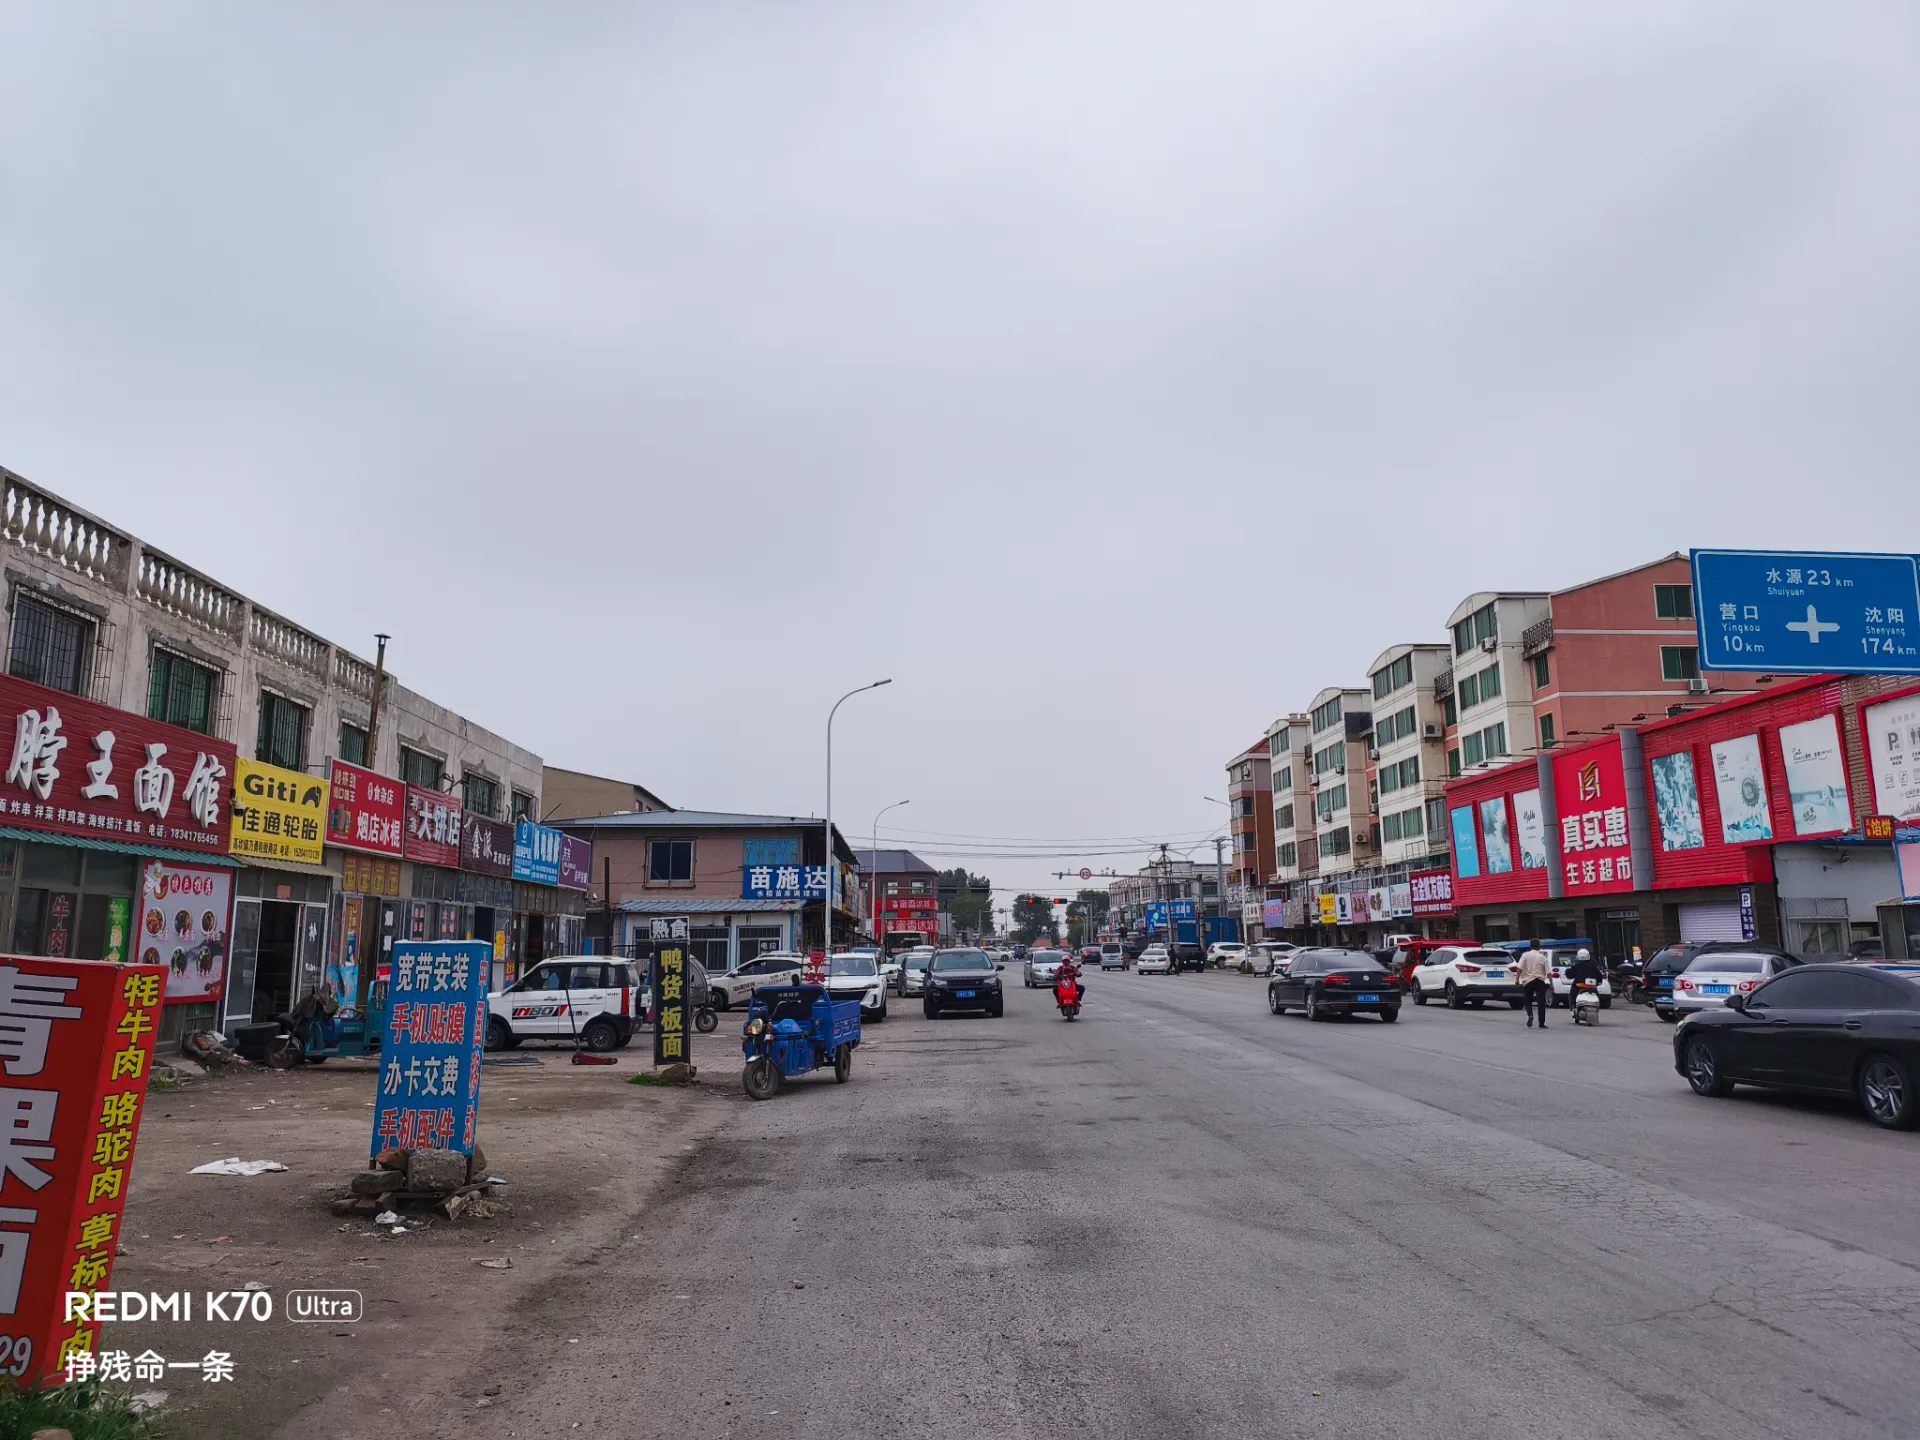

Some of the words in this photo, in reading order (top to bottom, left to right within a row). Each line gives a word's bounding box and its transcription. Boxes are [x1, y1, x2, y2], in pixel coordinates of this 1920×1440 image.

[1766, 568, 1803, 585] 水源
[1767, 587, 1805, 597] Shuiyuan
[1719, 603, 1759, 621] 营口
[1722, 623, 1761, 634] Yingkou
[1864, 607, 1904, 624] 沈阳
[1865, 626, 1905, 637] Shenyang
[243, 774, 297, 803] Giti
[240, 806, 318, 841] 佳通轮胎
[356, 810, 401, 848] 烟店冰棍
[417, 800, 461, 847] 大饼店
[1561, 806, 1629, 854] 真实惠
[1870, 820, 1892, 837] 馅饼
[170, 873, 213, 896] 特色推荐
[749, 866, 827, 890] 苗施达
[1566, 856, 1632, 886] 生活超市
[651, 918, 687, 939] 熟食
[395, 952, 471, 992] 宽带安装
[660, 949, 683, 1001] 鸭货
[111, 973, 161, 1082] 牦牛肉
[390, 1002, 467, 1044] 手机贴膜
[660, 1007, 683, 1057] 板面
[463, 951, 489, 1149] 中国移动
[384, 1055, 460, 1098] 办卡交费
[378, 1107, 455, 1152] 手机配件
[87, 1091, 139, 1205] 骆驼肉
